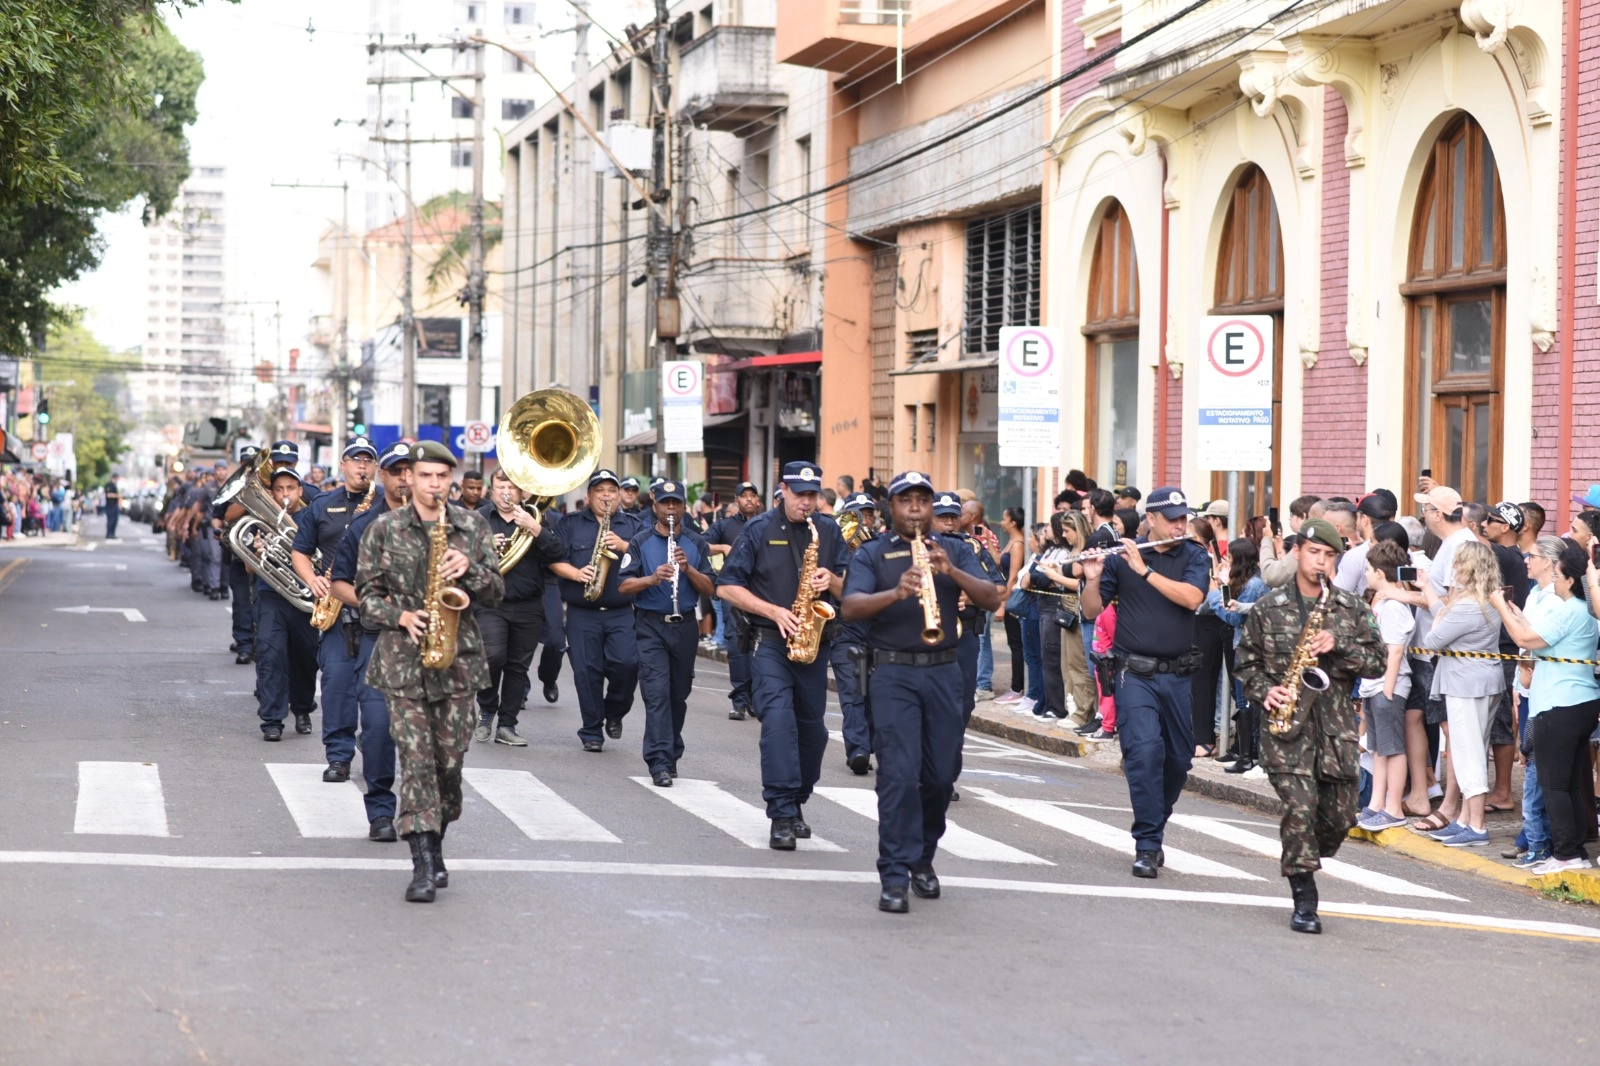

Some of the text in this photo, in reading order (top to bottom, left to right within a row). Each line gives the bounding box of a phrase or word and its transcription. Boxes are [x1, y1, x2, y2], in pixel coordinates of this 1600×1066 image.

[1022, 340, 1039, 367] E
[1225, 332, 1244, 364] E
[677, 371, 688, 388] E
[831, 417, 858, 435] 1004
[1253, 416, 1269, 424] PAGO
